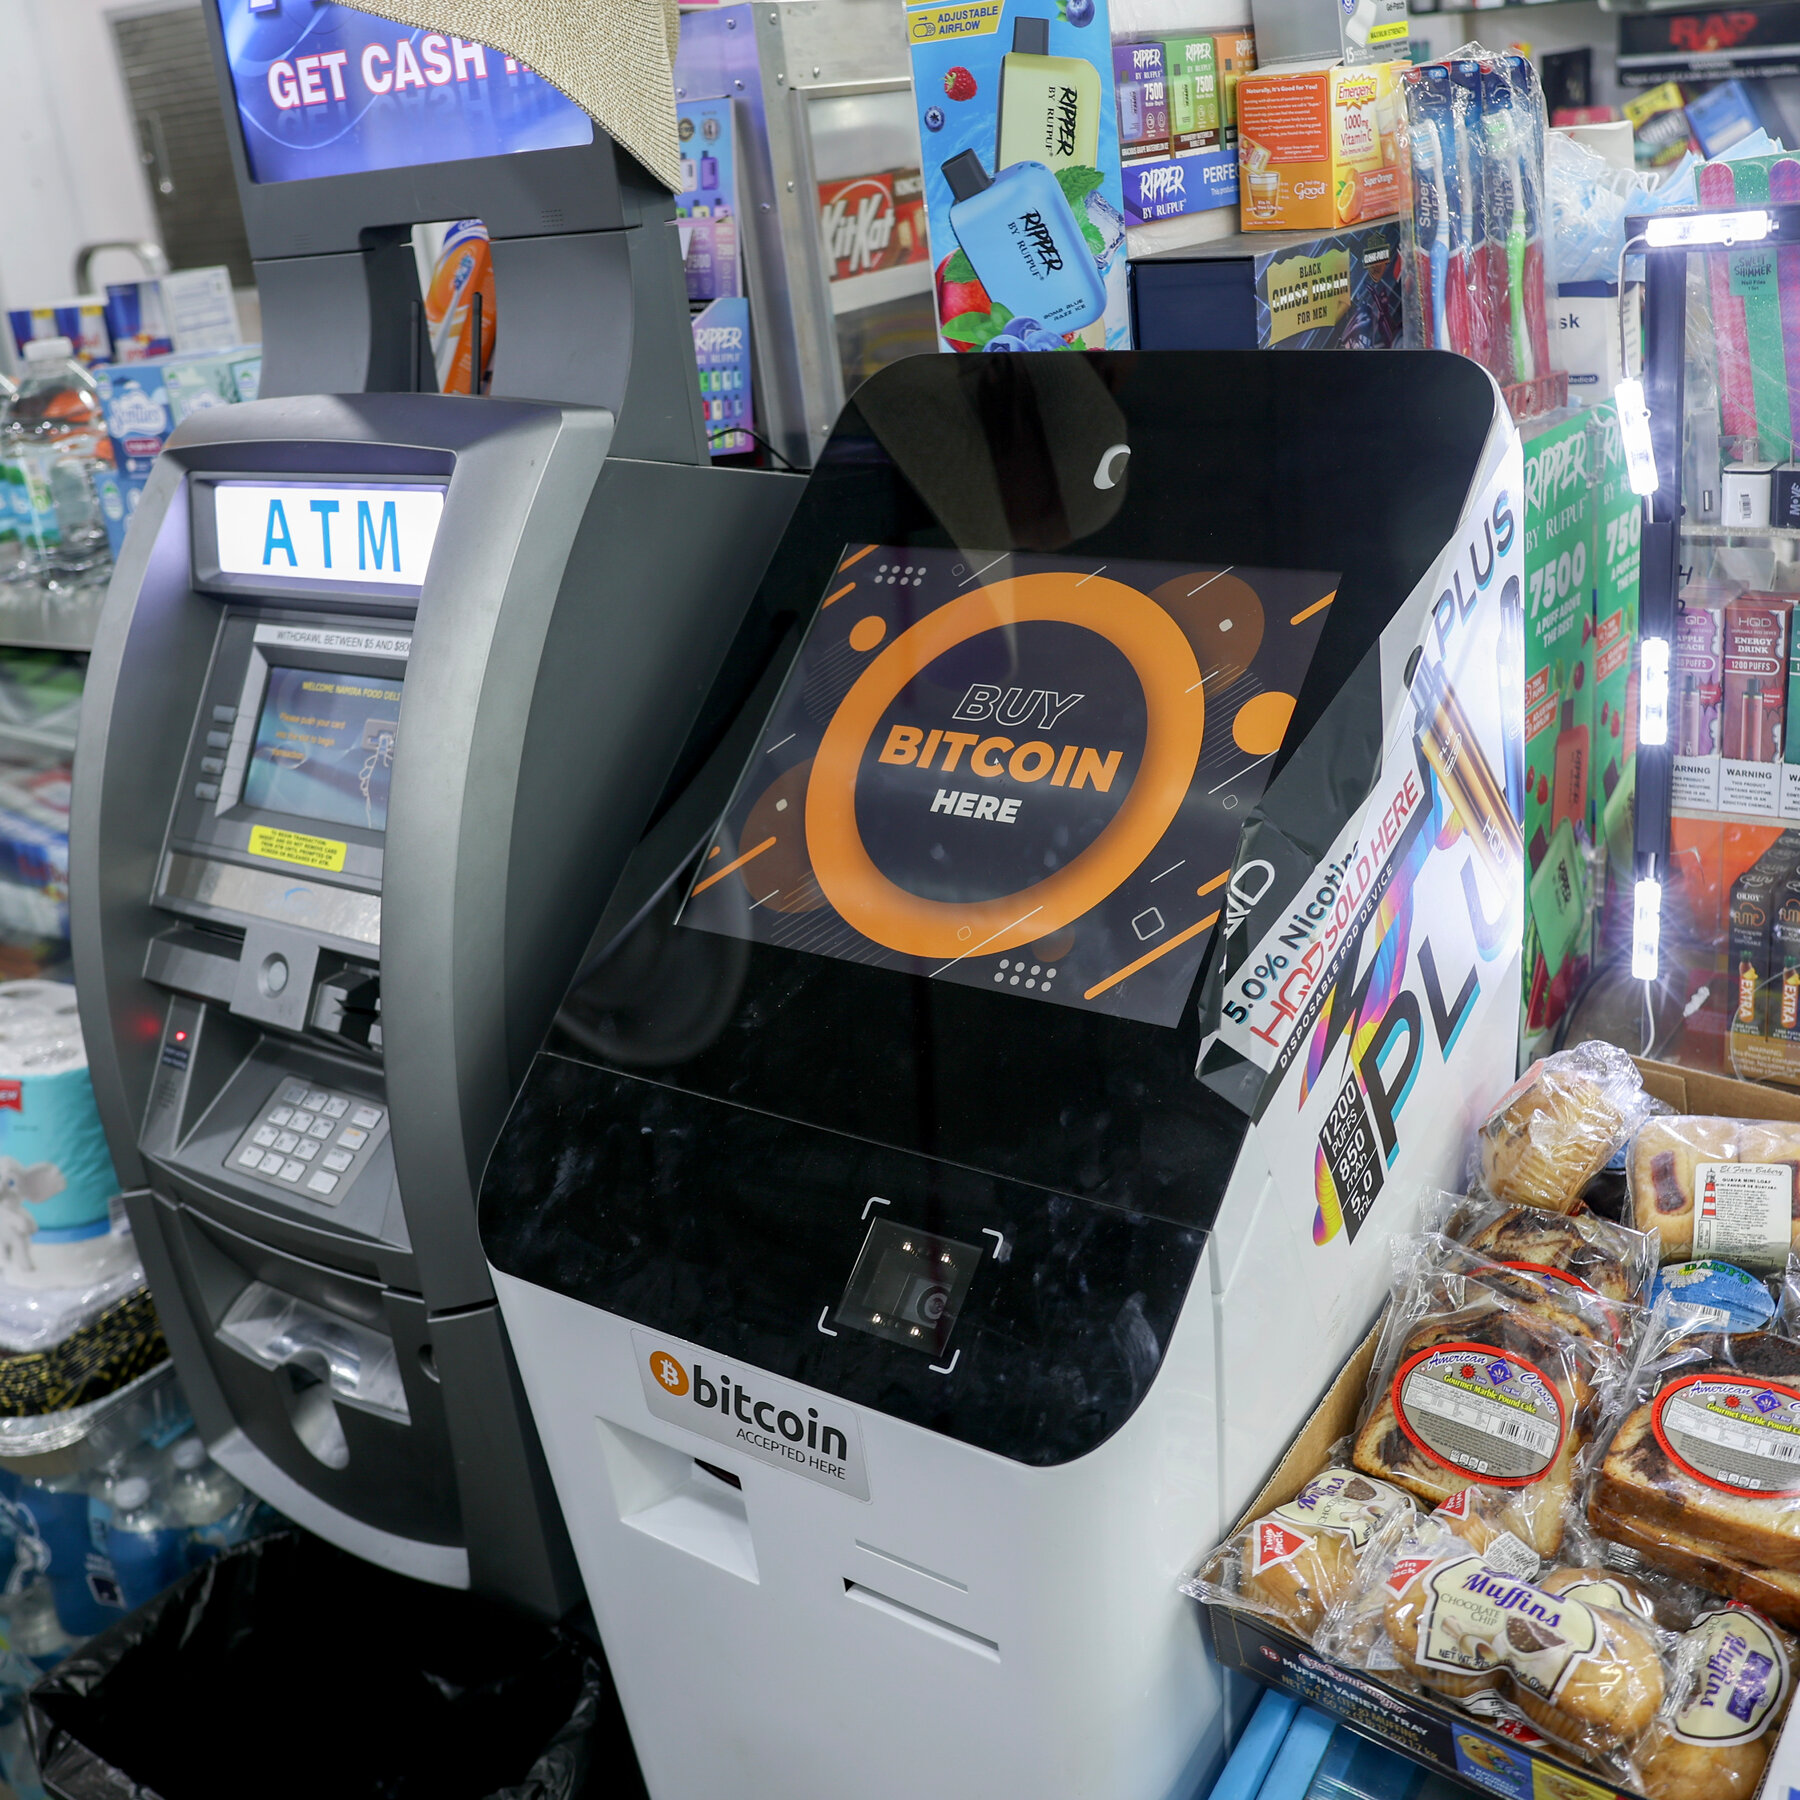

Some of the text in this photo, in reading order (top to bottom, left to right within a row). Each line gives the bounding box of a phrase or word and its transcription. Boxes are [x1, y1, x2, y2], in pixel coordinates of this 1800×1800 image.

[938, 6, 999, 23] ADJUSTABLE
[939, 21, 981, 35] AIRFLOW
[1132, 49, 1162, 69] RIPPER
[1185, 43, 1212, 62] RIPPER
[1345, 47, 1354, 63] 15
[267, 34, 489, 111] GET CASH
[1195, 75, 1214, 93] 7500
[1143, 82, 1164, 101] 7500
[1338, 81, 1376, 100] Emergen-C
[1045, 86, 1056, 152] BY RUFPUF
[1055, 84, 1077, 158] RIPPER
[1341, 128, 1372, 147] Vitamin C
[1139, 165, 1186, 202] RIPPER
[1203, 163, 1239, 184] PERFE
[1294, 182, 1326, 200] Good
[1142, 201, 1185, 220] BY RUFPUF
[1420, 181, 1431, 228] Super
[1493, 173, 1504, 218] Super
[1008, 221, 1041, 281] BY RUFPUF
[1017, 207, 1064, 277] RIPPER
[1299, 262, 1322, 279] BLACK
[1734, 263, 1772, 278] SHIMMER
[1272, 271, 1349, 314] CHASE DREAM
[1297, 305, 1328, 325] FOR MEN
[696, 326, 743, 353] RIPPER
[1524, 429, 1590, 518] RIPPER
[1603, 481, 1616, 506] BY
[262, 499, 402, 573] ATM
[1525, 496, 1585, 553] BY RUFPUF
[1605, 503, 1641, 567] 750
[1431, 489, 1517, 662] PLUS
[1529, 541, 1587, 620] 7500
[1536, 591, 1581, 637] A PUFF ABOVE
[1543, 613, 1575, 648] THE REST
[1738, 617, 1772, 628] HQD
[324, 634, 363, 648] BETWEEN
[376, 640, 393, 651] AND
[394, 641, 411, 652] $80
[1734, 636, 1773, 646] ENERGY
[1737, 645, 1769, 654] DRINK
[1685, 659, 1707, 669] PUFFS
[1731, 660, 1771, 671] 1200 PUFFS
[363, 688, 384, 700] FOOD
[952, 683, 1085, 731] BUY
[878, 724, 1124, 793] BITCOIN
[1726, 768, 1772, 780] WARNING
[929, 788, 1023, 824] HERE
[1250, 769, 1420, 1048] HQD SOLD HERE
[1221, 951, 1290, 1026] 5.0%
[1280, 840, 1360, 951] Nicotin
[1279, 862, 1394, 1069] DISPOSABLE POD DEVICE
[1359, 855, 1512, 1171] PLU
[1740, 978, 1754, 1020] EXTRA
[1782, 984, 1797, 1029] EXTRA
[0, 1090, 18, 1100] EW
[1321, 1080, 1357, 1146] 1200
[1331, 1108, 1358, 1158] PUFFS
[1339, 1128, 1366, 1182] 850
[1346, 1152, 1368, 1192] mAh
[1755, 1166, 1784, 1176] Bakery
[1350, 1169, 1373, 1214] 5.0
[1357, 1194, 1373, 1221] mL
[1684, 1262, 1753, 1285] DAISY'S
[1427, 1351, 1558, 1414] American Classic
[1443, 1374, 1537, 1414] Gourmet Marble Pound Cake
[1689, 1380, 1752, 1397] American
[692, 1364, 848, 1462] bitcoin
[1706, 1402, 1792, 1433] Gourmet Marble Pound
[736, 1428, 847, 1481] ACCEPTED HERE
[1264, 1526, 1274, 1553] Twin
[1274, 1530, 1284, 1555] Pack
[1440, 1593, 1502, 1619] CHOCOLATE
[1461, 1573, 1562, 1628] Muffins
[1470, 1611, 1498, 1627] CHIP
[1438, 1649, 1455, 1660] NET
[1281, 1674, 1301, 1691] NET
[1282, 1657, 1429, 1736] MUFFIN VARIETY TRAY
[1295, 1673, 1307, 1685] 15
[1371, 1712, 1419, 1742] MUFFINS
